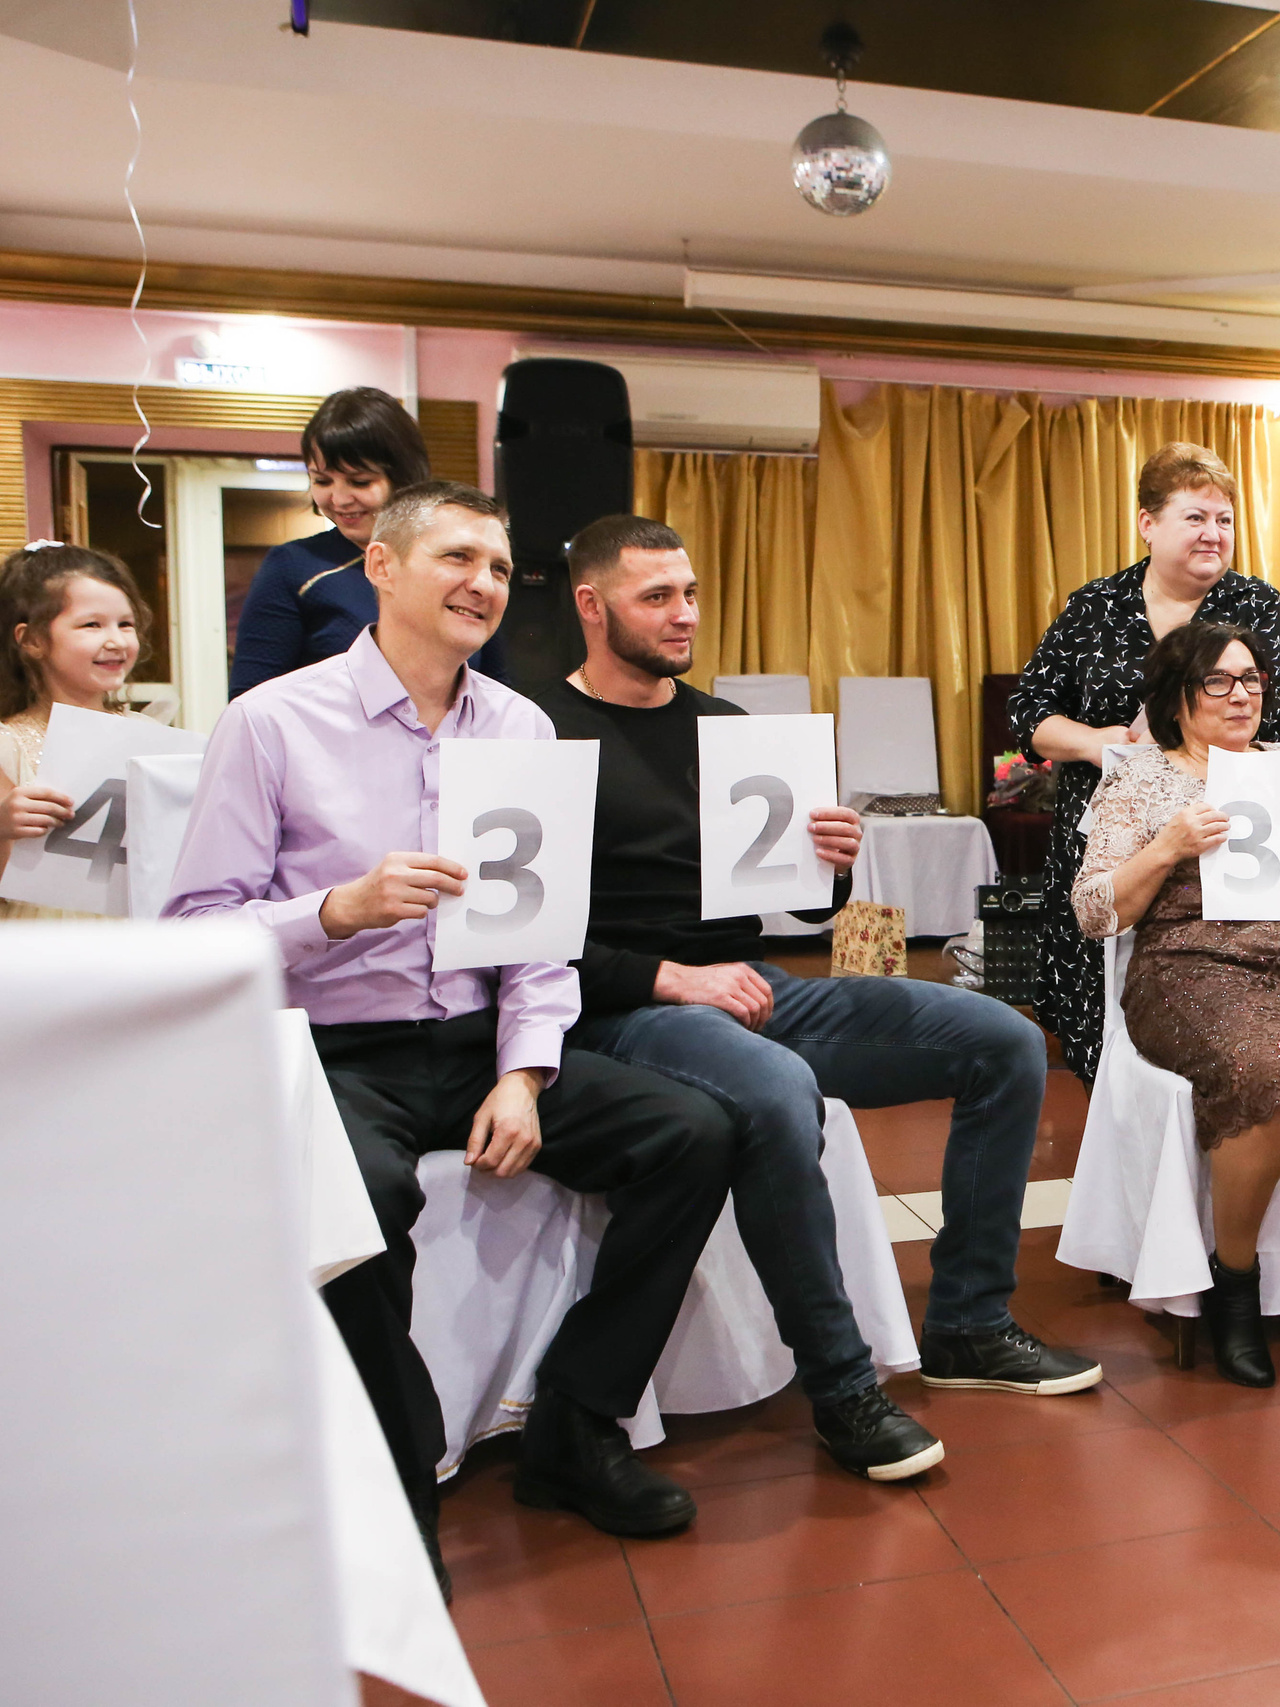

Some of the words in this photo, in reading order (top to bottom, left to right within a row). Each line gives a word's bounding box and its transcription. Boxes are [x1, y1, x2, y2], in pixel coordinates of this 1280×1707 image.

[44, 778, 127, 884] 4
[465, 807, 545, 935] 3
[729, 774, 798, 888] 2
[1218, 800, 1280, 895] 3
